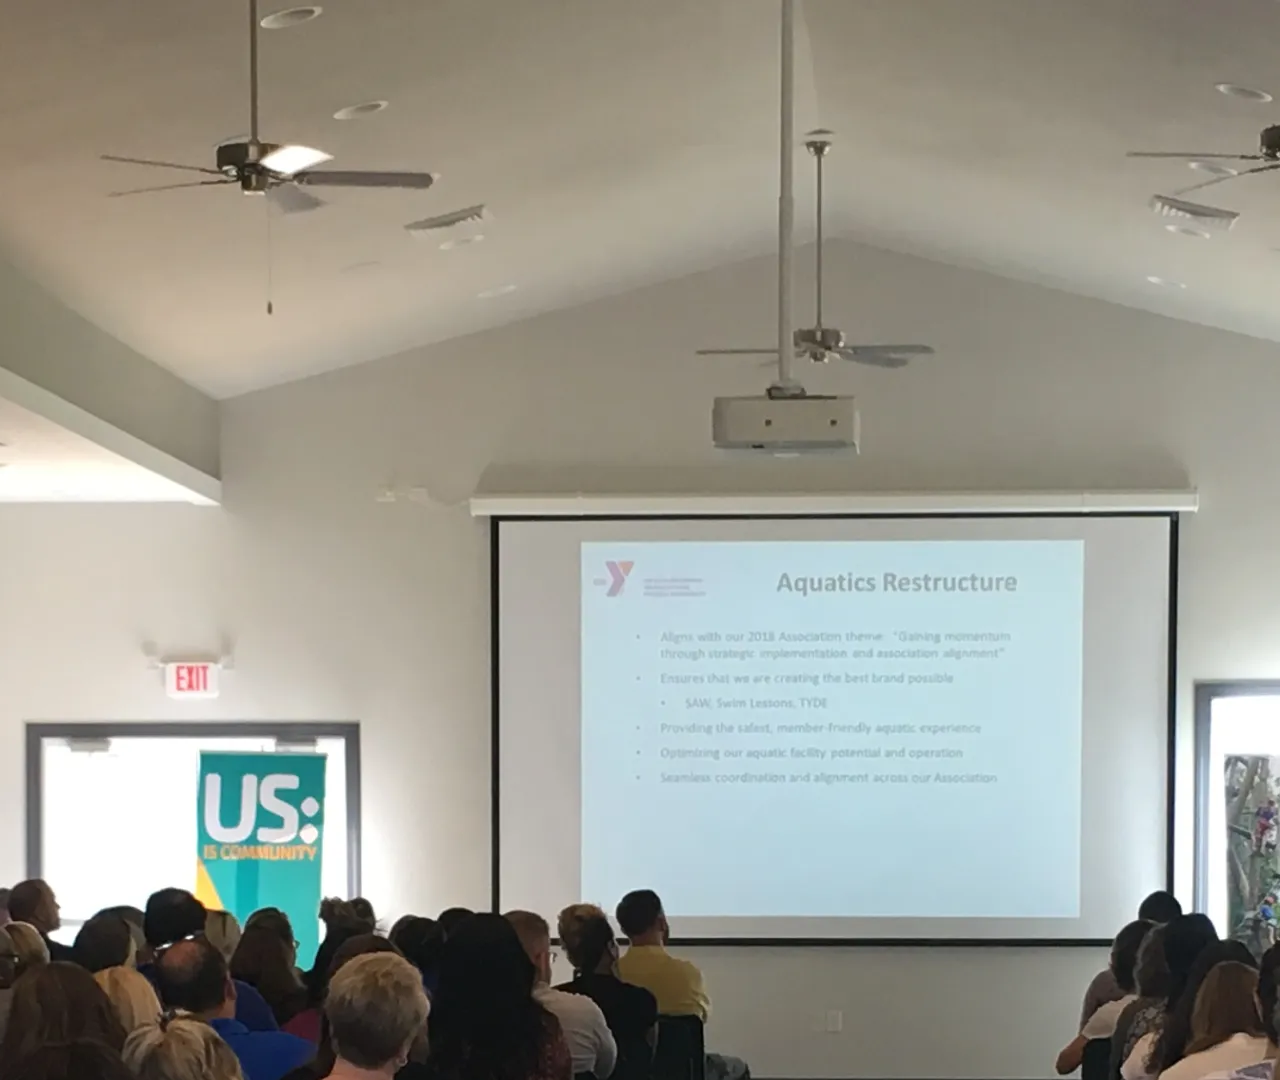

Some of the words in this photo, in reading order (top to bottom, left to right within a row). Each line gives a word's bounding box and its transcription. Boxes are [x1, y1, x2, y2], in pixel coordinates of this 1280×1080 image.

[776, 571, 876, 597] Aquatics
[883, 572, 1017, 592] Restructure
[697, 632, 721, 642] with
[725, 634, 744, 642] our
[778, 632, 842, 643] Association
[944, 632, 1011, 642] momentum
[660, 648, 705, 661] through
[708, 649, 755, 661] strategic
[759, 648, 848, 661] implementation
[852, 647, 874, 659] and
[876, 649, 939, 659] association
[176, 665, 209, 691] EXIT
[660, 672, 704, 684] Ensures
[707, 673, 729, 684] that
[733, 675, 750, 684] we
[752, 675, 771, 685] are
[774, 672, 820, 687] creating
[823, 672, 841, 683] the
[844, 672, 869, 683] best
[872, 672, 905, 683] brand
[908, 672, 954, 685] possible
[661, 723, 713, 736] Providing
[715, 722, 735, 734] the
[875, 724, 916, 736] aquatic
[919, 724, 981, 735] experience
[723, 749, 744, 758] our
[745, 747, 788, 760] aquatic
[790, 747, 827, 760] facility
[830, 747, 881, 761] potential
[884, 746, 906, 760] and
[908, 748, 963, 760] operation
[715, 772, 786, 783] coordination
[789, 771, 811, 783] and
[813, 772, 869, 785] alignment
[873, 774, 909, 783] across
[911, 774, 932, 783] our
[934, 772, 997, 783] Association
[204, 773, 320, 845] US:
[203, 846, 217, 860] IS
[220, 845, 318, 861] COMMUNITY
